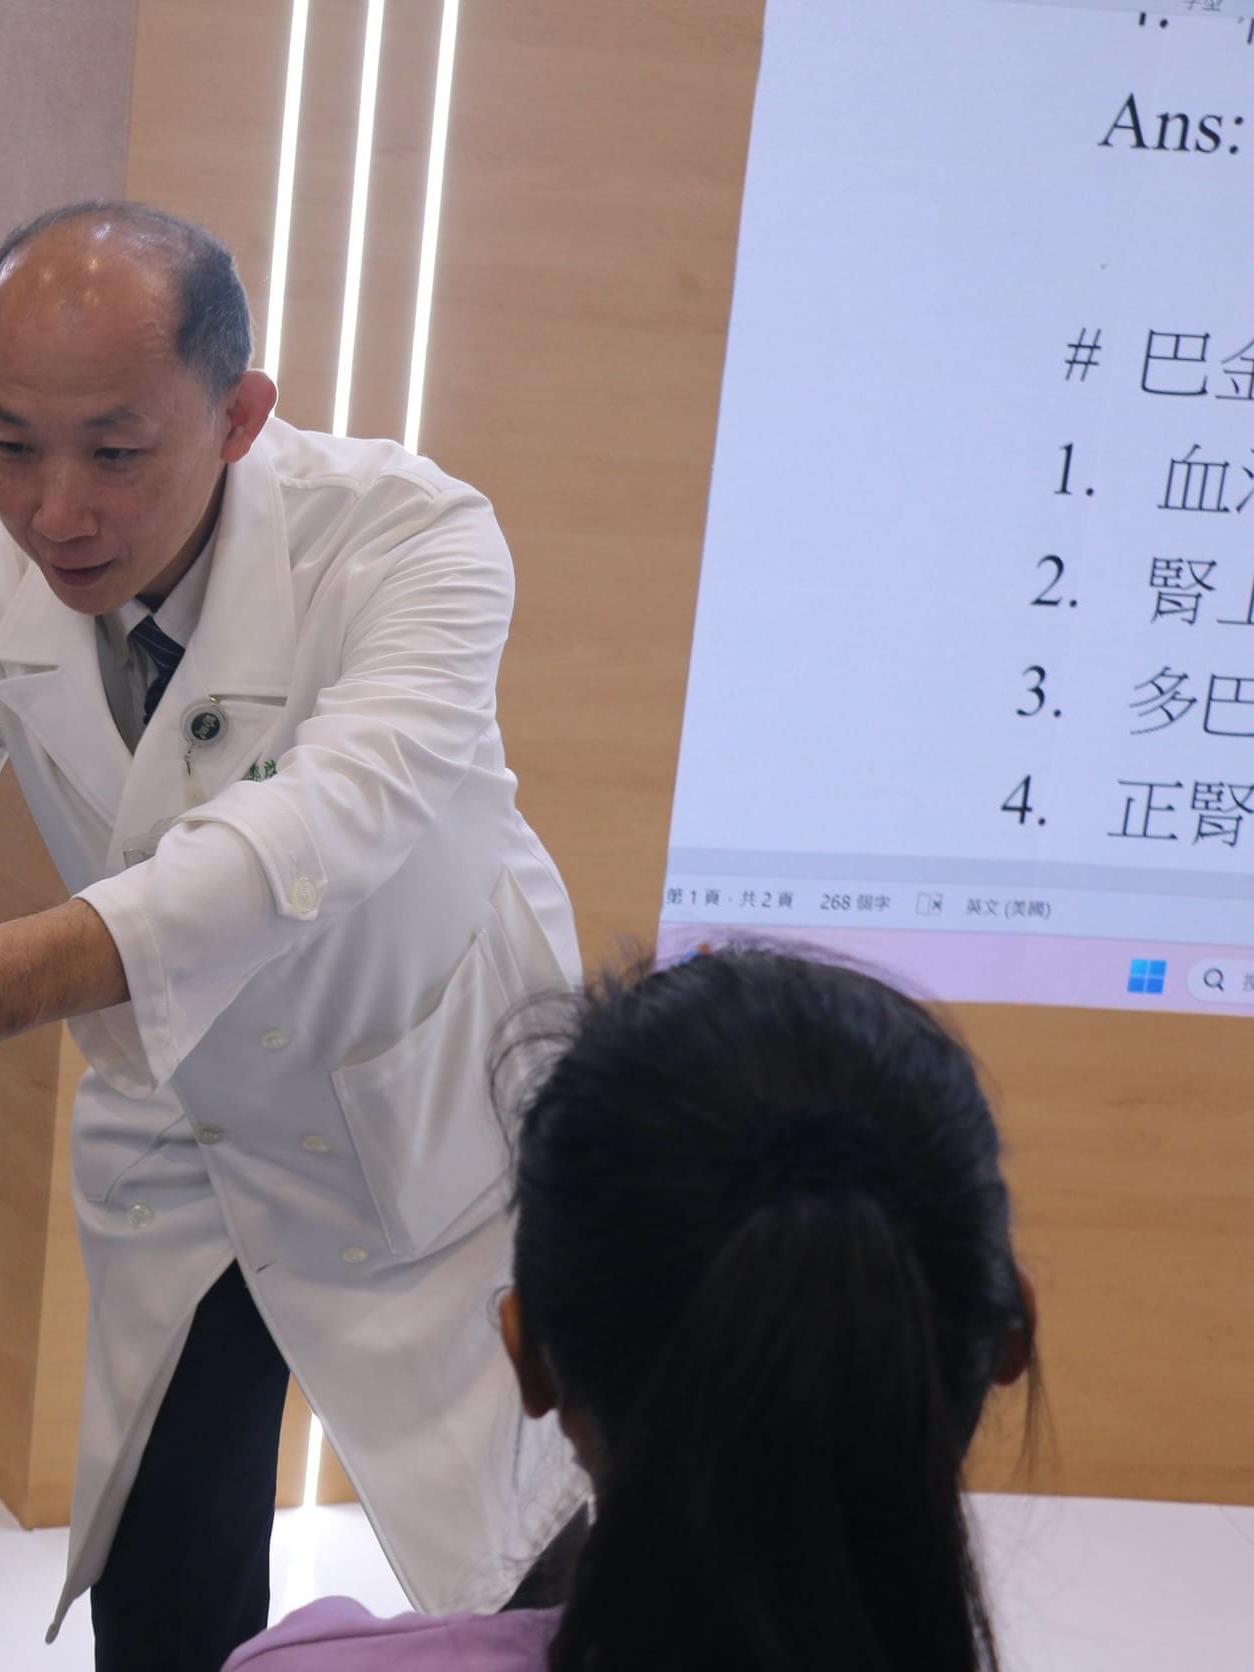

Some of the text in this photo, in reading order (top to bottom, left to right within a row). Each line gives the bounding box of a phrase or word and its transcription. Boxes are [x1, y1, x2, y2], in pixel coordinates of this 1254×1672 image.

[1097, 92, 1245, 155] Ans:
[1063, 326, 1102, 382] #
[1053, 441, 1254, 514] 1. 血
[1029, 554, 1078, 609] 2.
[1015, 664, 1254, 738] 3. 多巴
[1000, 774, 1254, 848] 4. 正腎
